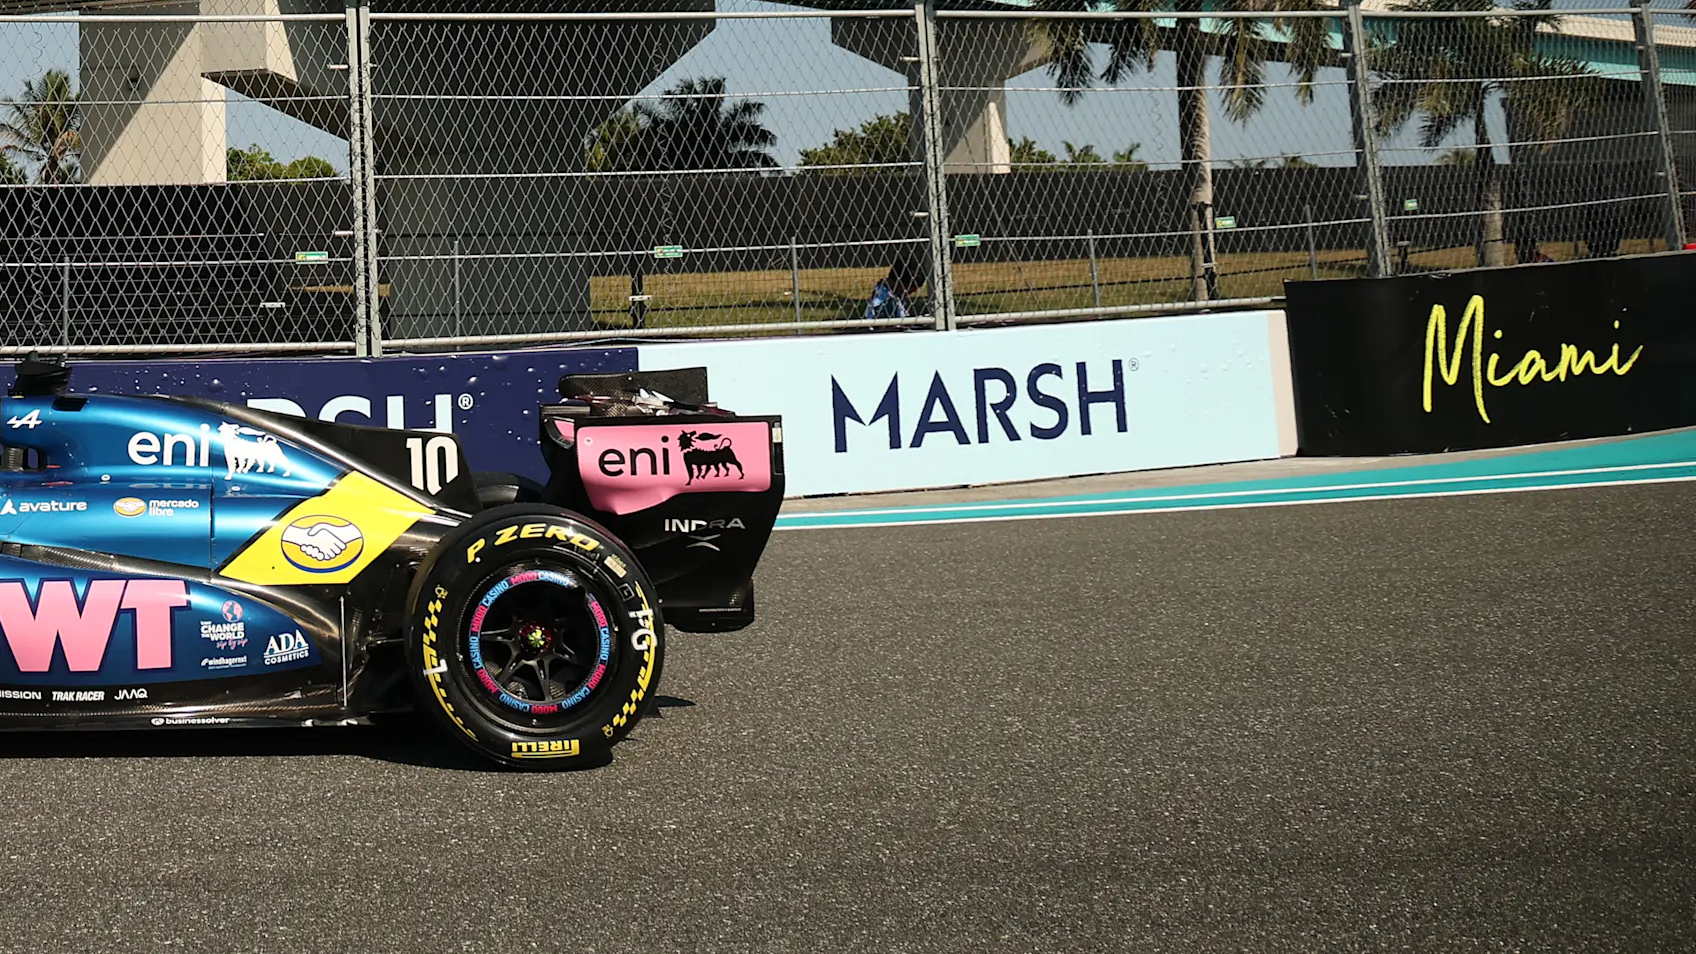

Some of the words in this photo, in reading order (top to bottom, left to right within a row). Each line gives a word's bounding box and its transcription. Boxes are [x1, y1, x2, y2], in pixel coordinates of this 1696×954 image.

[1422, 295, 1643, 423] Miami
[128, 423, 211, 467] eni
[406, 436, 459, 496] 10
[598, 436, 670, 477] eni
[19, 500, 88, 513] avature
[149, 498, 199, 509] mercado
[149, 507, 174, 517] libre
[665, 518, 745, 533] INDRA
[467, 538, 485, 563] P
[494, 523, 600, 551] ZERO
[482, 579, 509, 607] CASINO
[200, 622, 244, 634] CHANGE
[210, 631, 245, 641] WORLD
[263, 630, 309, 656] ADA
[469, 636, 483, 669] CASINO
[600, 627, 611, 661] CASINO
[264, 650, 309, 665] COSMETICS
[52, 691, 74, 701] TRAK
[75, 691, 105, 701] RACER
[499, 692, 530, 713] CASINO
[561, 685, 591, 709] CASINO
[165, 716, 230, 725] businessolver
[511, 739, 580, 759] PIRELLI
